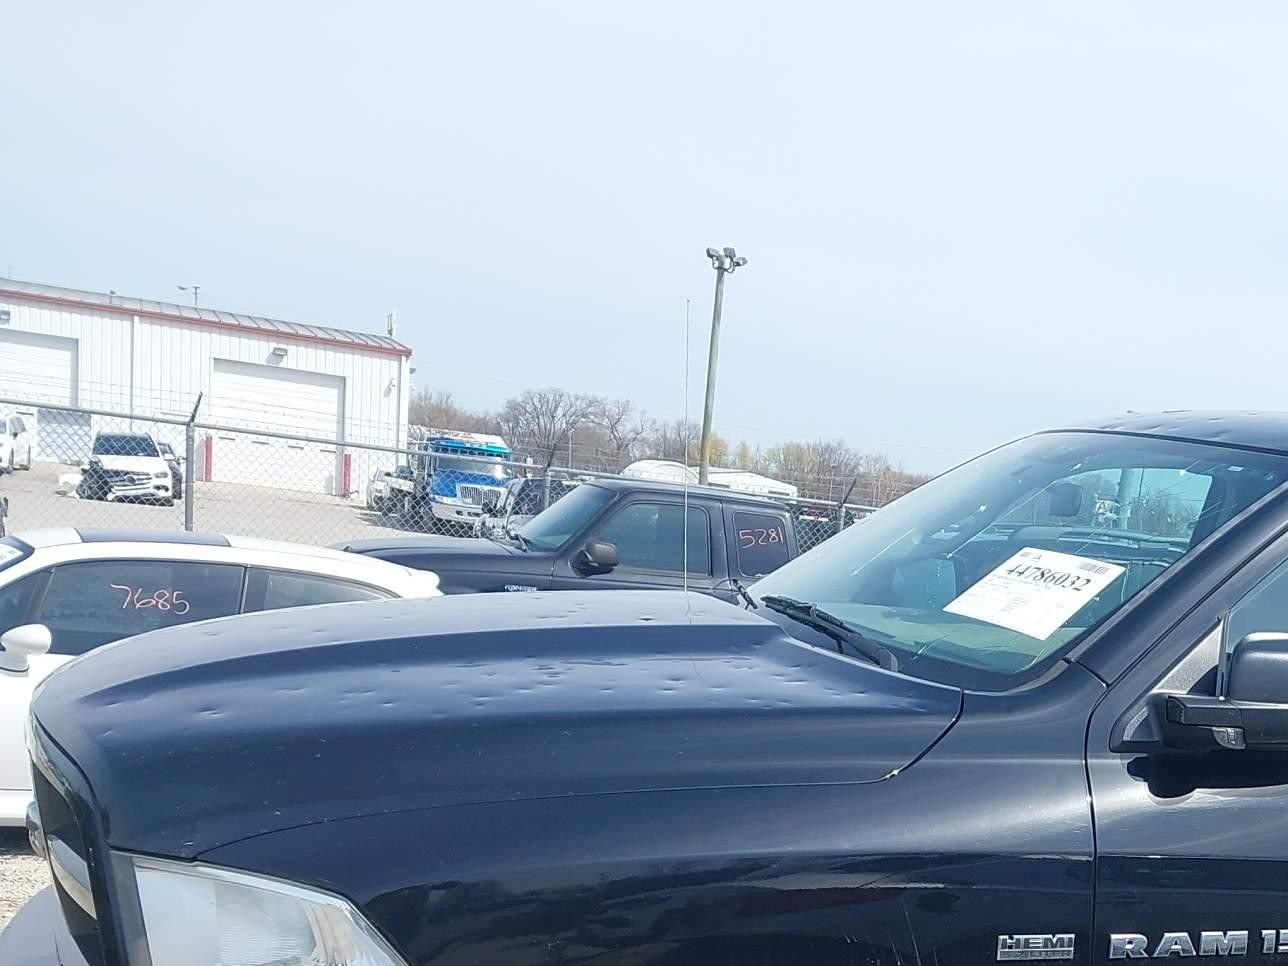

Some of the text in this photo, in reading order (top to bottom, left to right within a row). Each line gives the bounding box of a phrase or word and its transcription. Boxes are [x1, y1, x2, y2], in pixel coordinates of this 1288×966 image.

[739, 526, 784, 549] 5281
[1007, 564, 1091, 592] 44786032
[110, 583, 190, 615] 7685
[999, 934, 1075, 950] HEMI
[1108, 930, 1249, 960] RAM
